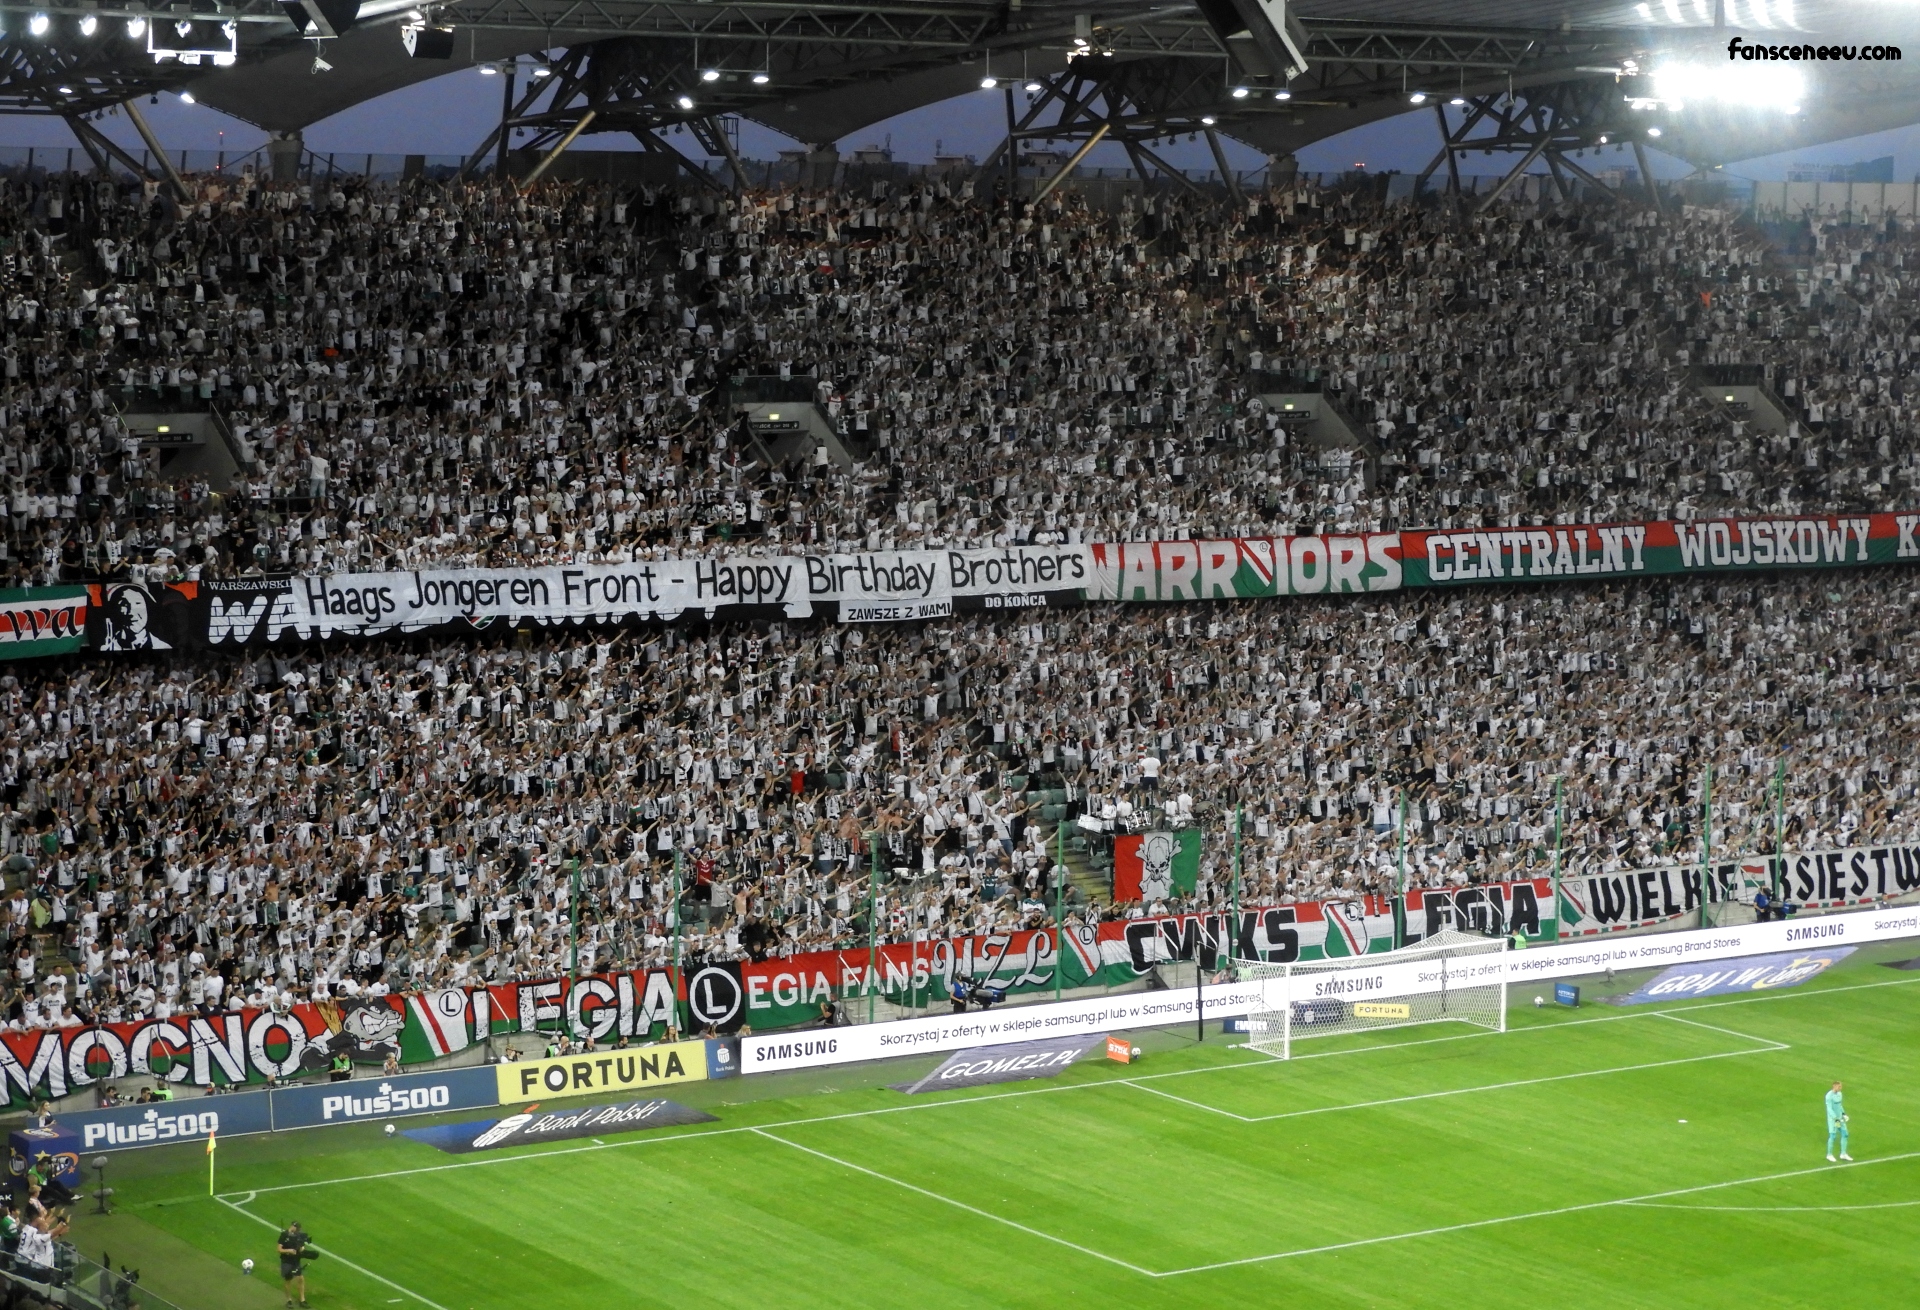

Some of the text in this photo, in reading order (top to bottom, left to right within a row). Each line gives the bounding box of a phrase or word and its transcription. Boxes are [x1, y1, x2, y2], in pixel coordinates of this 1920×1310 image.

[1425, 525, 1646, 581] CENTRALNY
[1674, 518, 1871, 567] WOJSKOWY
[209, 579, 293, 591] WARSZAWSKI
[305, 576, 396, 623] Haags
[409, 570, 549, 616] Jongeren
[562, 560, 660, 605] Front
[696, 559, 792, 603] Happy
[805, 555, 936, 598] Birthday
[949, 548, 1084, 588] Brothers
[848, 602, 951, 621] ZAWSZE Z WAMI
[985, 596, 1001, 608] DO
[1786, 923, 1845, 942] SAMSUNG
[1875, 916, 1918, 930] Skorzystaj
[1124, 907, 1300, 973] CWKS
[1510, 962, 1520, 971] w
[1521, 956, 1556, 971] sklepie
[1557, 949, 1611, 966] samsung.pl
[1613, 949, 1627, 961] lub
[1629, 950, 1638, 958] w
[1641, 944, 1683, 957] Samsung
[1685, 939, 1711, 952] Brand
[1713, 937, 1741, 949] Stores
[842, 957, 930, 998] FANS
[1315, 975, 1383, 997] SAMSUNG
[1648, 970, 1738, 994] GRAJ
[1728, 965, 1774, 986] W
[880, 1027, 941, 1047] Skorzystaj
[942, 1029, 949, 1039] z
[952, 1022, 986, 1039] oferty
[990, 1024, 1000, 1033] w
[1003, 1016, 1042, 1034] sklepie
[1045, 1010, 1109, 1029] samsung.pl
[1110, 1007, 1127, 1020] lub
[1130, 1007, 1140, 1017] w
[1143, 1001, 1193, 1014] Samsung
[1358, 1005, 1404, 1015] FORTUNA
[756, 1038, 838, 1062] SAMSUNG
[941, 1048, 1082, 1080] GOMEZ.PL
[520, 1051, 686, 1096] FORTUNA
[322, 1084, 450, 1119] Plus500
[525, 1109, 592, 1134] Bank
[586, 1100, 667, 1126] Polski
[84, 1110, 219, 1147] Plus500
